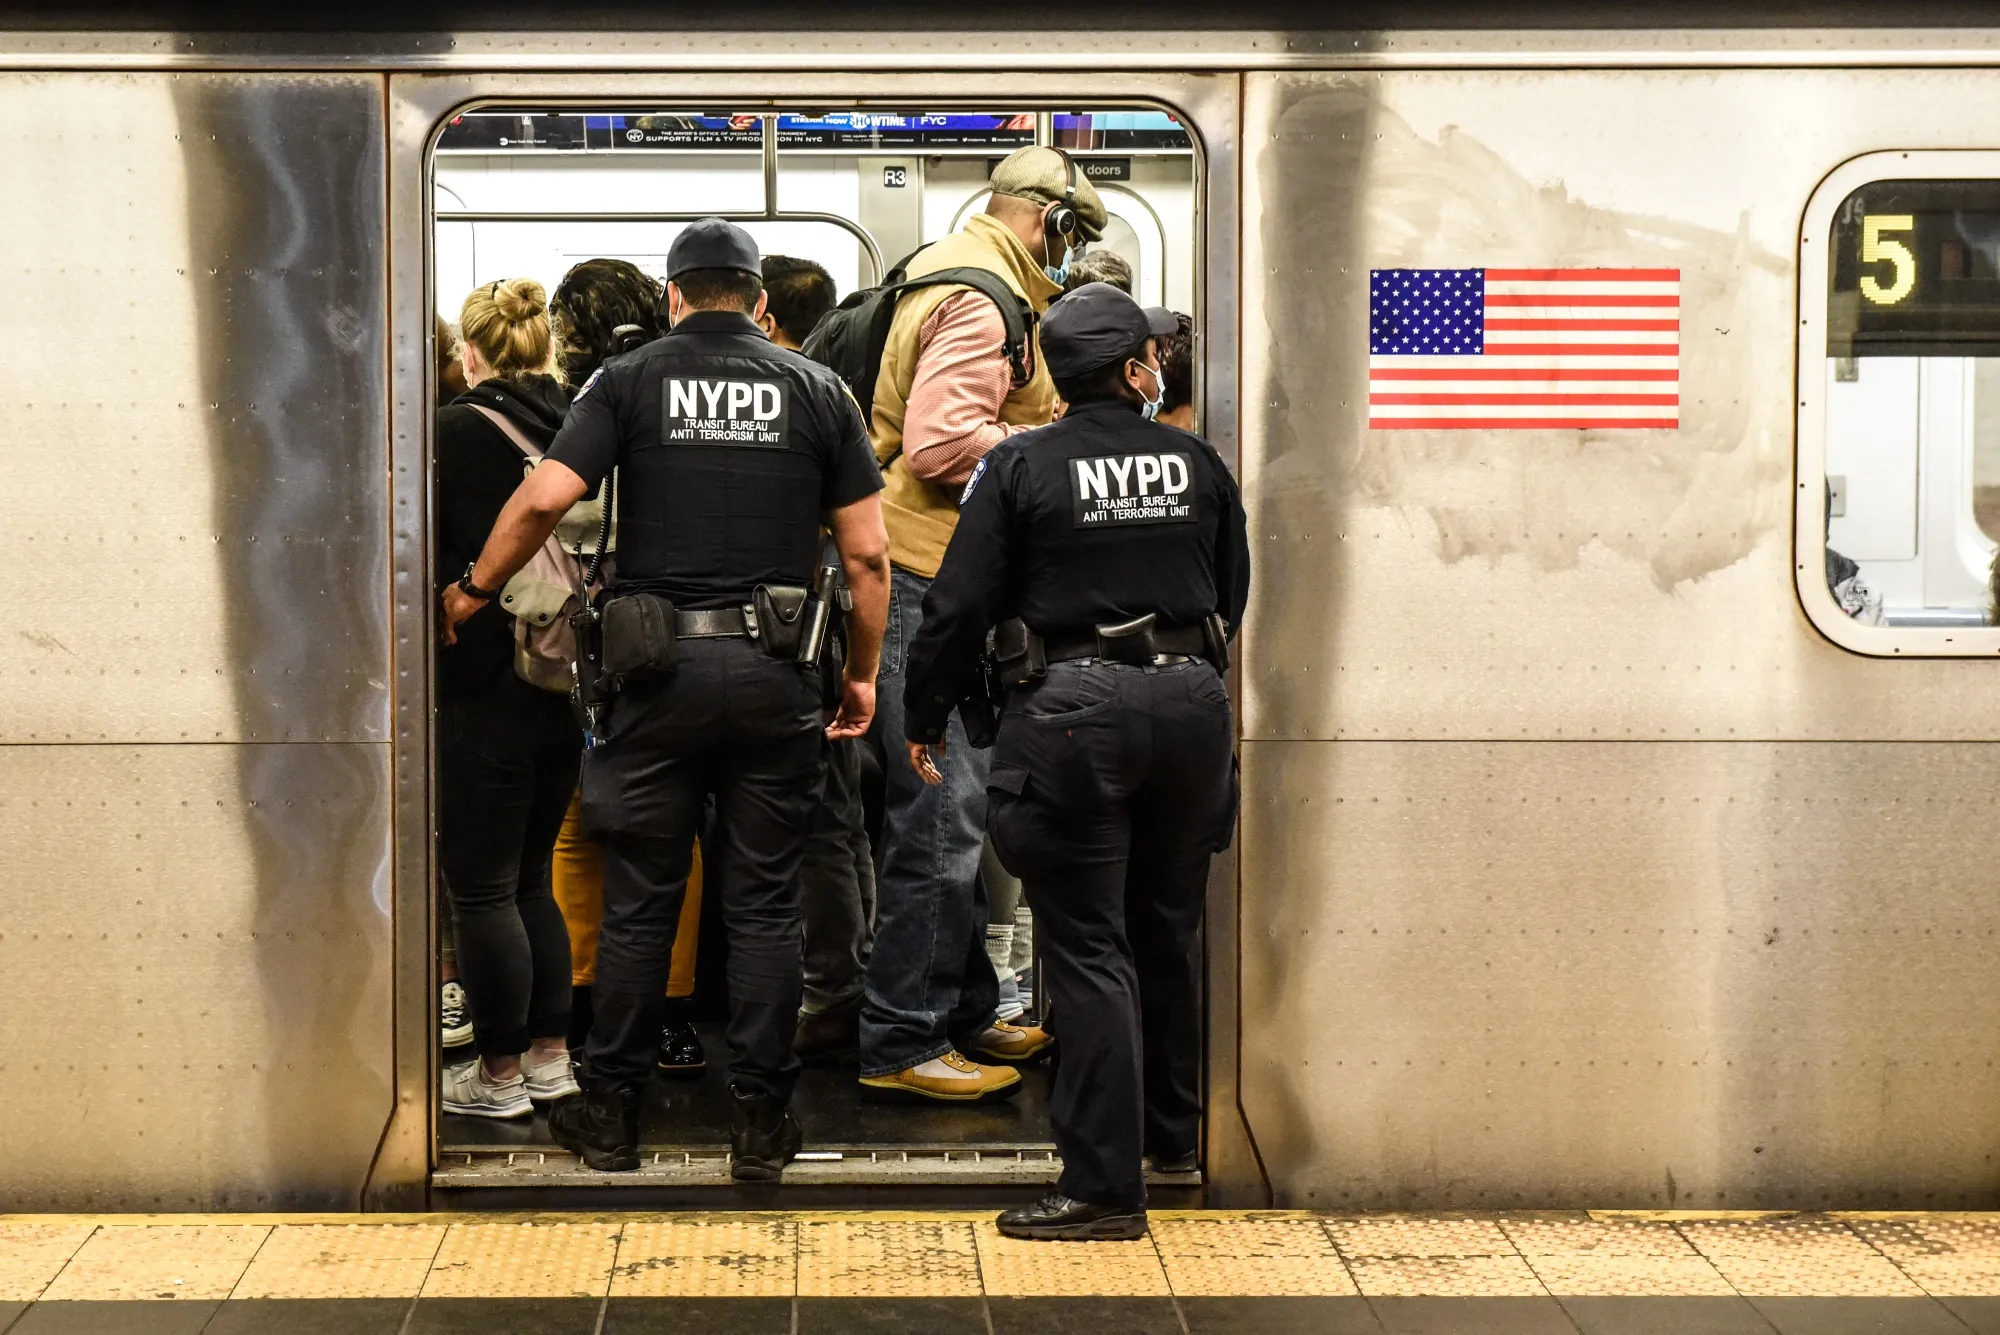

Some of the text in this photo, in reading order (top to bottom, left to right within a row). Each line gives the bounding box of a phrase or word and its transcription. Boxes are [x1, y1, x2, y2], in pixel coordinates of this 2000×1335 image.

[849, 115, 906, 129] SHOWTIME
[921, 116, 947, 126] FYC
[884, 170, 906, 185] R3
[1087, 164, 1122, 176] doors
[1860, 215, 1915, 304] 5
[669, 379, 782, 421] NYPD
[683, 418, 768, 432] TRANSIT BUREAU
[670, 428, 781, 443] ANTI TERRORISM UNIT
[1076, 454, 1189, 500] NYPD
[1095, 495, 1179, 510] TRANSIT BUREAU
[1082, 505, 1190, 523] ANTI TERRORISM UNIT
